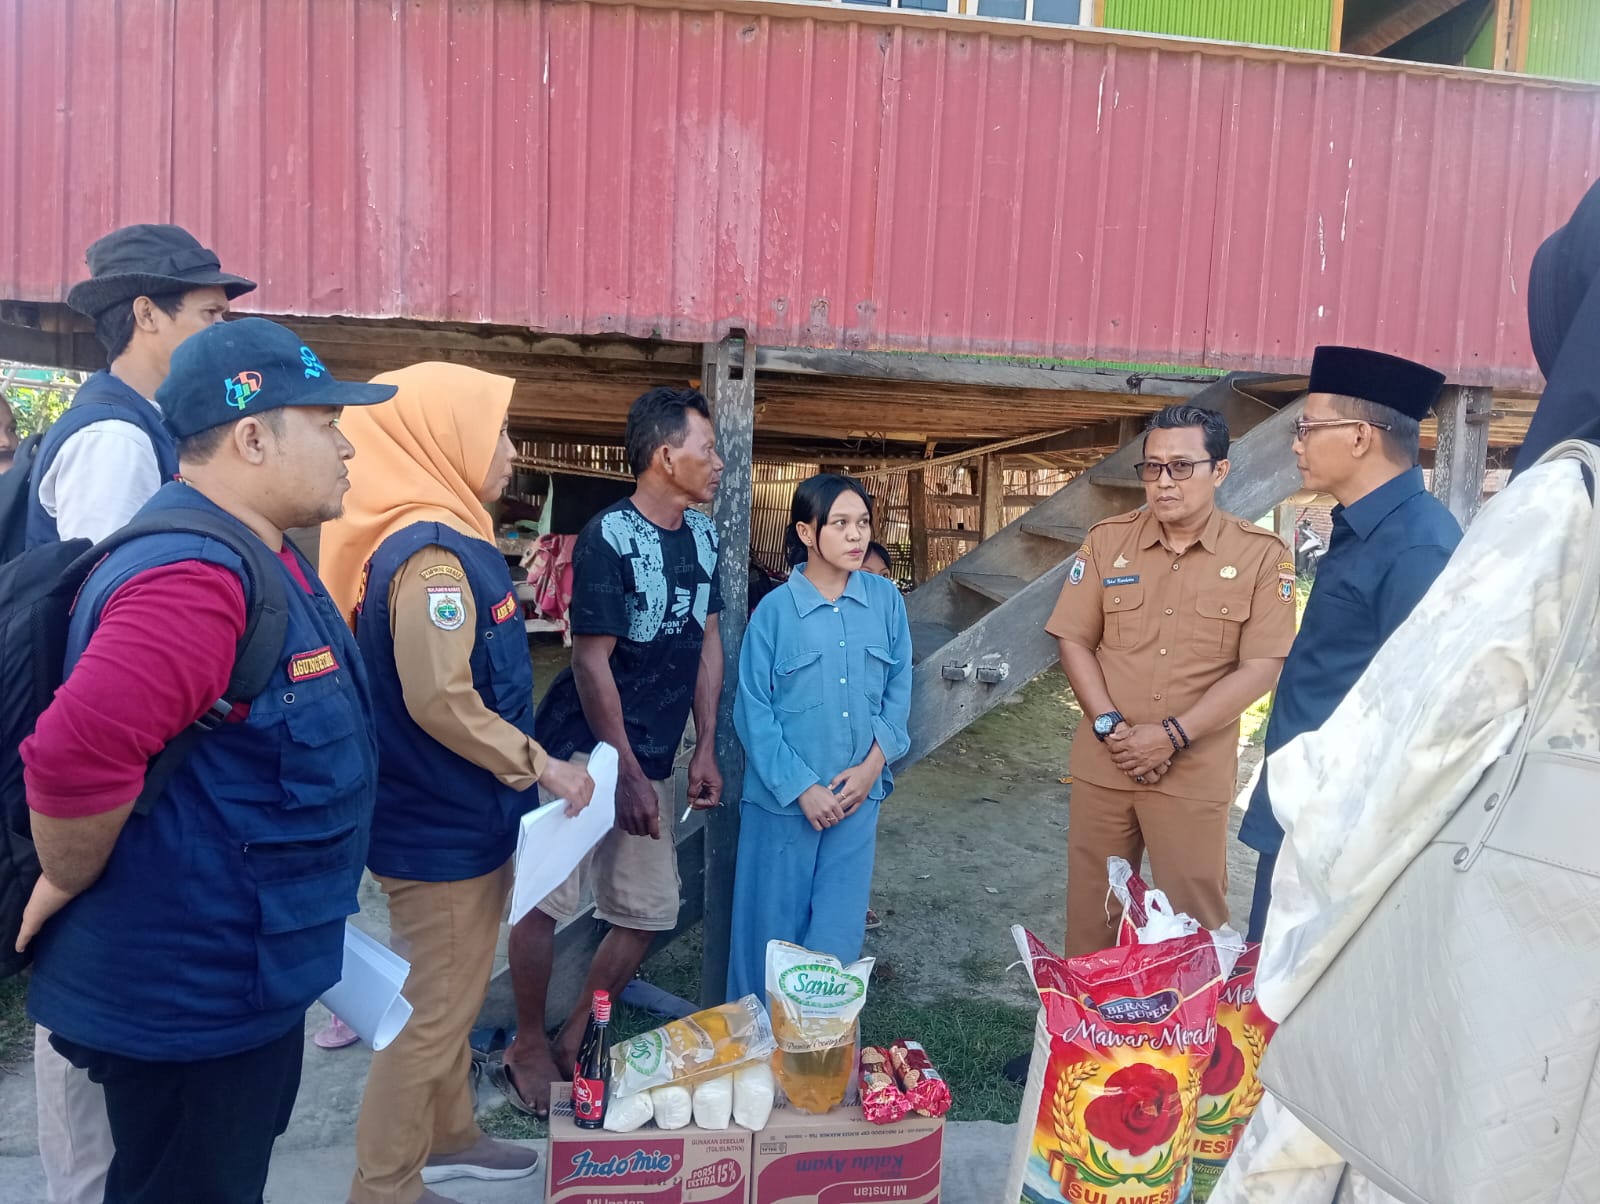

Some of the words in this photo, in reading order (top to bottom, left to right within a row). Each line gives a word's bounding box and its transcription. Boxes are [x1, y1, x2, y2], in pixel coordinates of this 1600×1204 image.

[793, 972, 847, 996] Sania
[1106, 1002, 1150, 1015] BERAS
[1127, 1004, 1170, 1020] SUPER
[1062, 1018, 1149, 1050] Mawar
[693, 1164, 716, 1180] PORSI
[717, 1160, 736, 1184] 15%
[796, 1154, 847, 1173] Ayam
[852, 1154, 904, 1173] Kaldu
[687, 1175, 716, 1188] EKSTRA
[892, 1184, 907, 1196] Mi
[853, 1185, 891, 1198] Instan
[1069, 1183, 1174, 1204] SULAWESI
